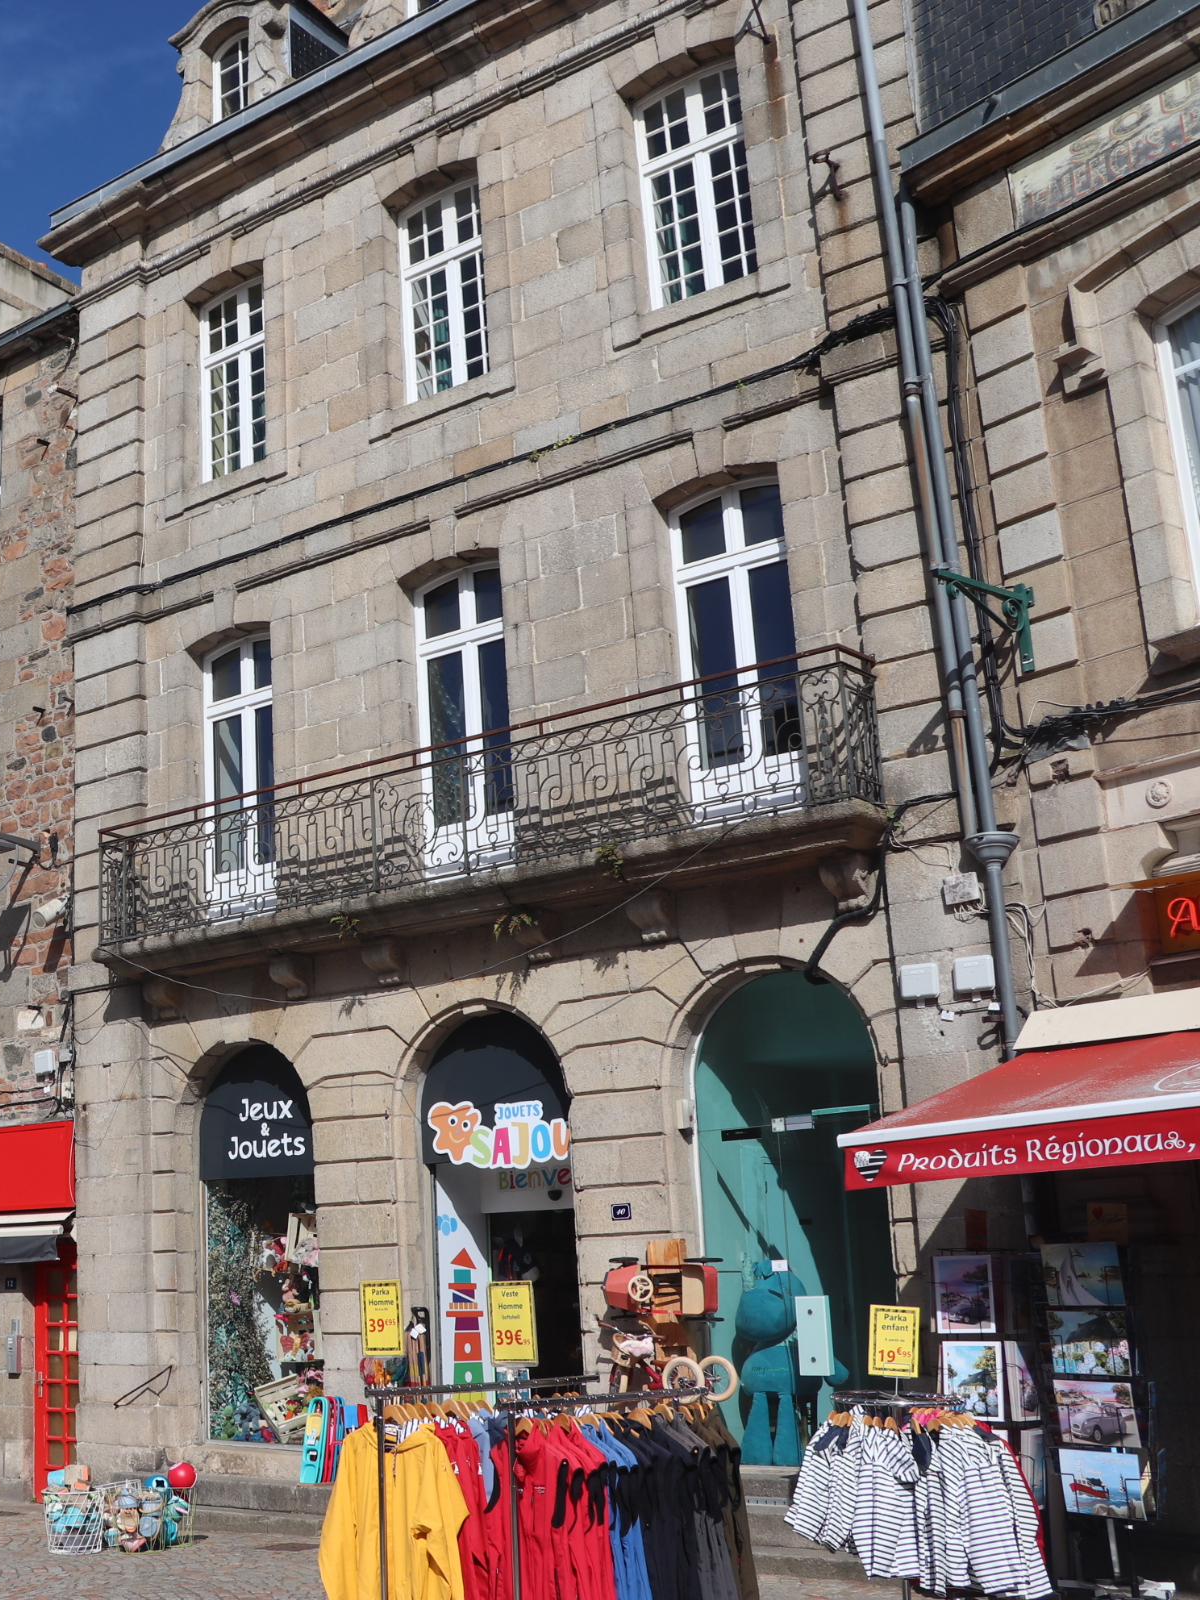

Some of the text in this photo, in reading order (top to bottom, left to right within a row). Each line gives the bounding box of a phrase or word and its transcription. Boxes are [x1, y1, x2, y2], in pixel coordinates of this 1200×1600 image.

[239, 1098, 293, 1122] Jeux
[497, 1103, 541, 1120] JOUETS
[260, 1122, 270, 1137] &
[228, 1132, 306, 1160] Jouets
[469, 1121, 571, 1166] SAJOU
[897, 1143, 1018, 1173] Produits
[615, 1207, 626, 1216] 10
[371, 1288, 390, 1296] Parka
[498, 1302, 523, 1310] Homme
[884, 1313, 907, 1322] Parka
[881, 1323, 909, 1332] enfant
